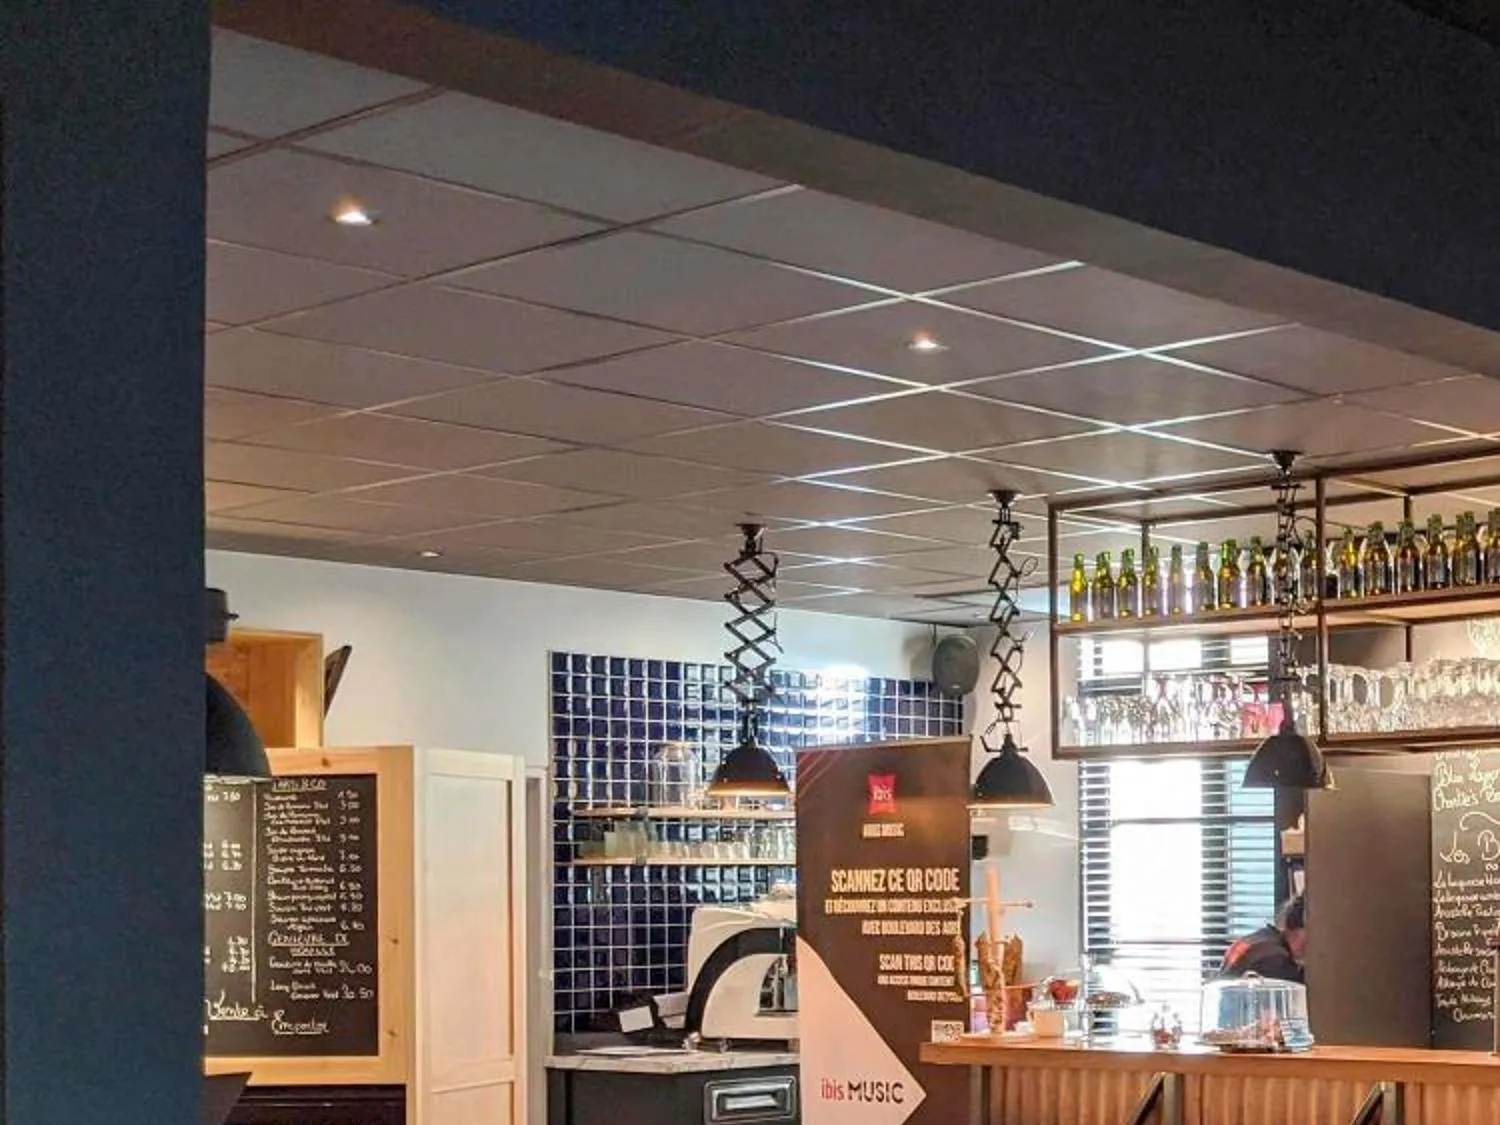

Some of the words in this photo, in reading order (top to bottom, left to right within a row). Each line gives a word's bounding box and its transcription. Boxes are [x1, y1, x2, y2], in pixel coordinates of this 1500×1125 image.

[831, 869, 886, 893] SCANNEZ
[888, 869, 905, 892] CE
[906, 868, 924, 893] QR
[925, 868, 960, 892] CODE
[937, 955, 955, 972] CO
[821, 1077, 845, 1101] ibis
[847, 1081, 904, 1104] MUSIC
